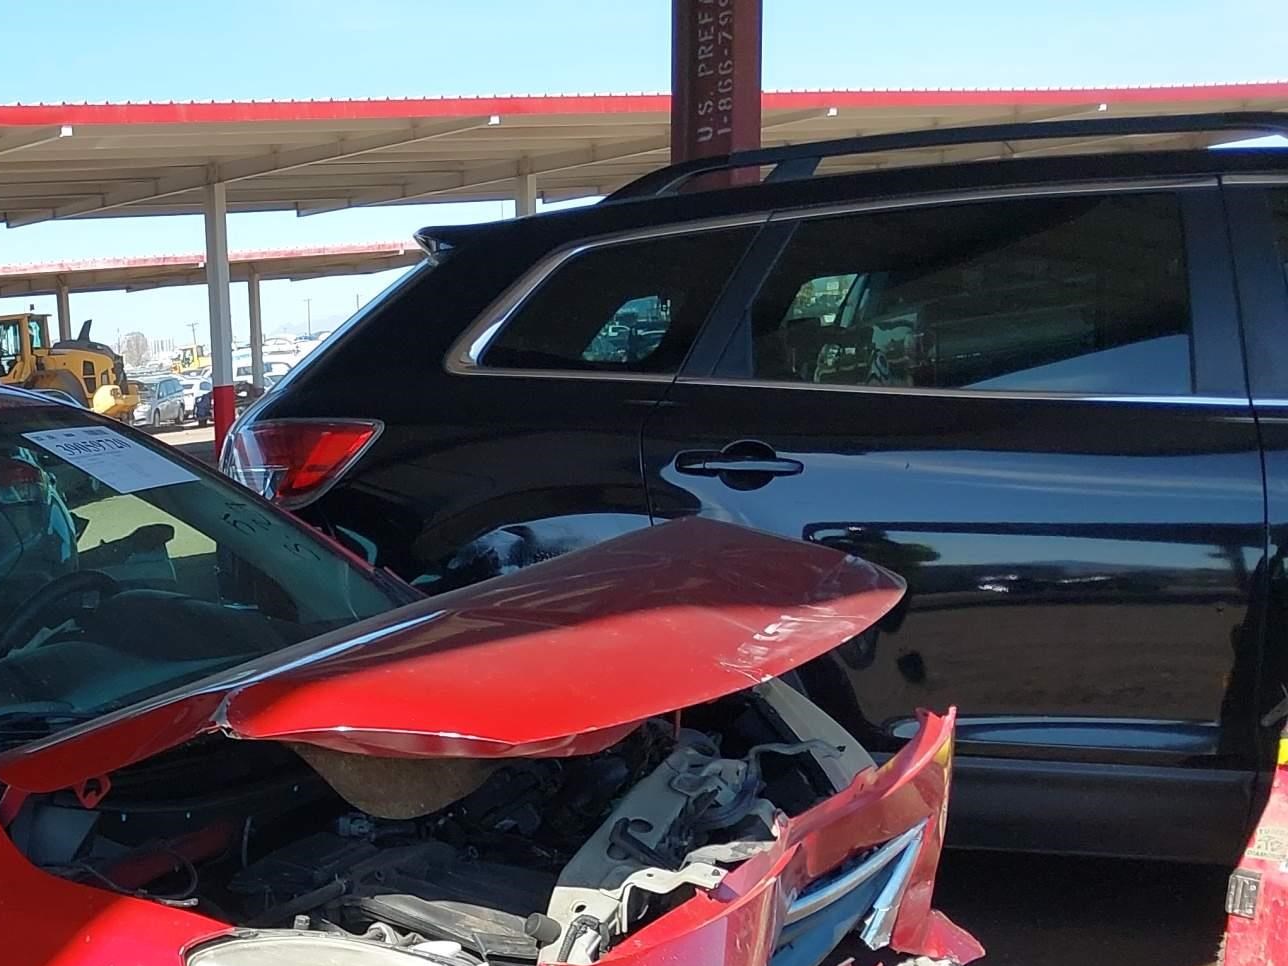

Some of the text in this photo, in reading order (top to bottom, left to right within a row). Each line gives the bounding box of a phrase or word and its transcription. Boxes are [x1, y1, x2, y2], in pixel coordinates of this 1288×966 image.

[697, 0, 714, 142] U.S. PREF
[55, 438, 132, 456] 39059720
